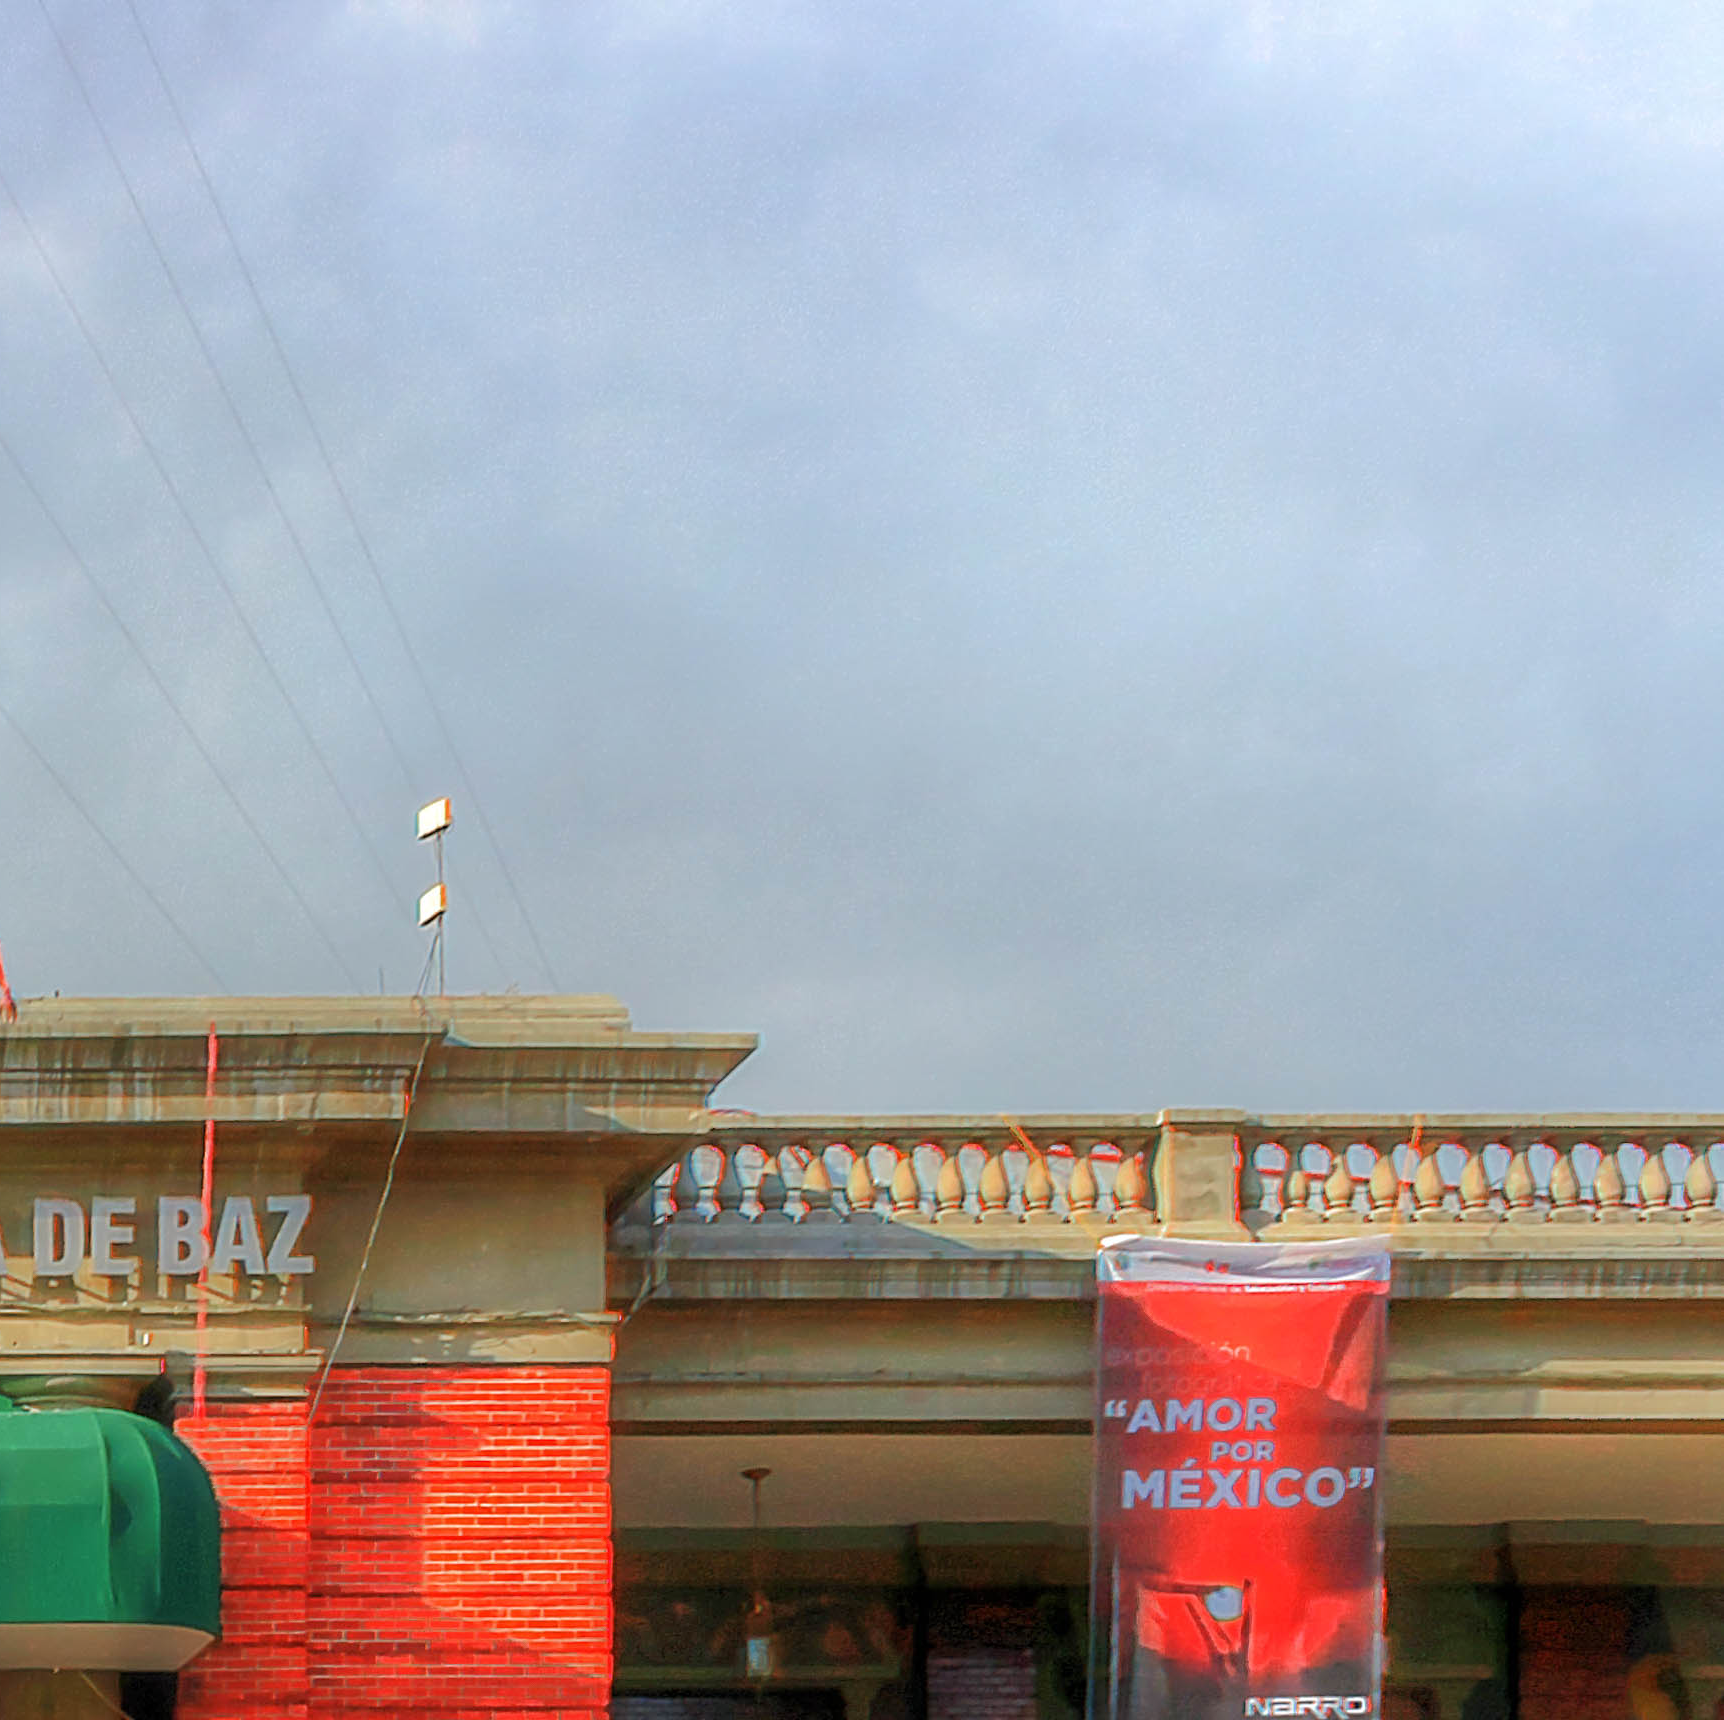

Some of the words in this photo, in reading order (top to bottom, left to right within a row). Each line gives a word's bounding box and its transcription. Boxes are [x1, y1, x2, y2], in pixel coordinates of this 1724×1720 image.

[32, 1196, 138, 1276] DE
[155, 1194, 316, 1277] BAZ
[1210, 1440, 1275, 1463] POR
